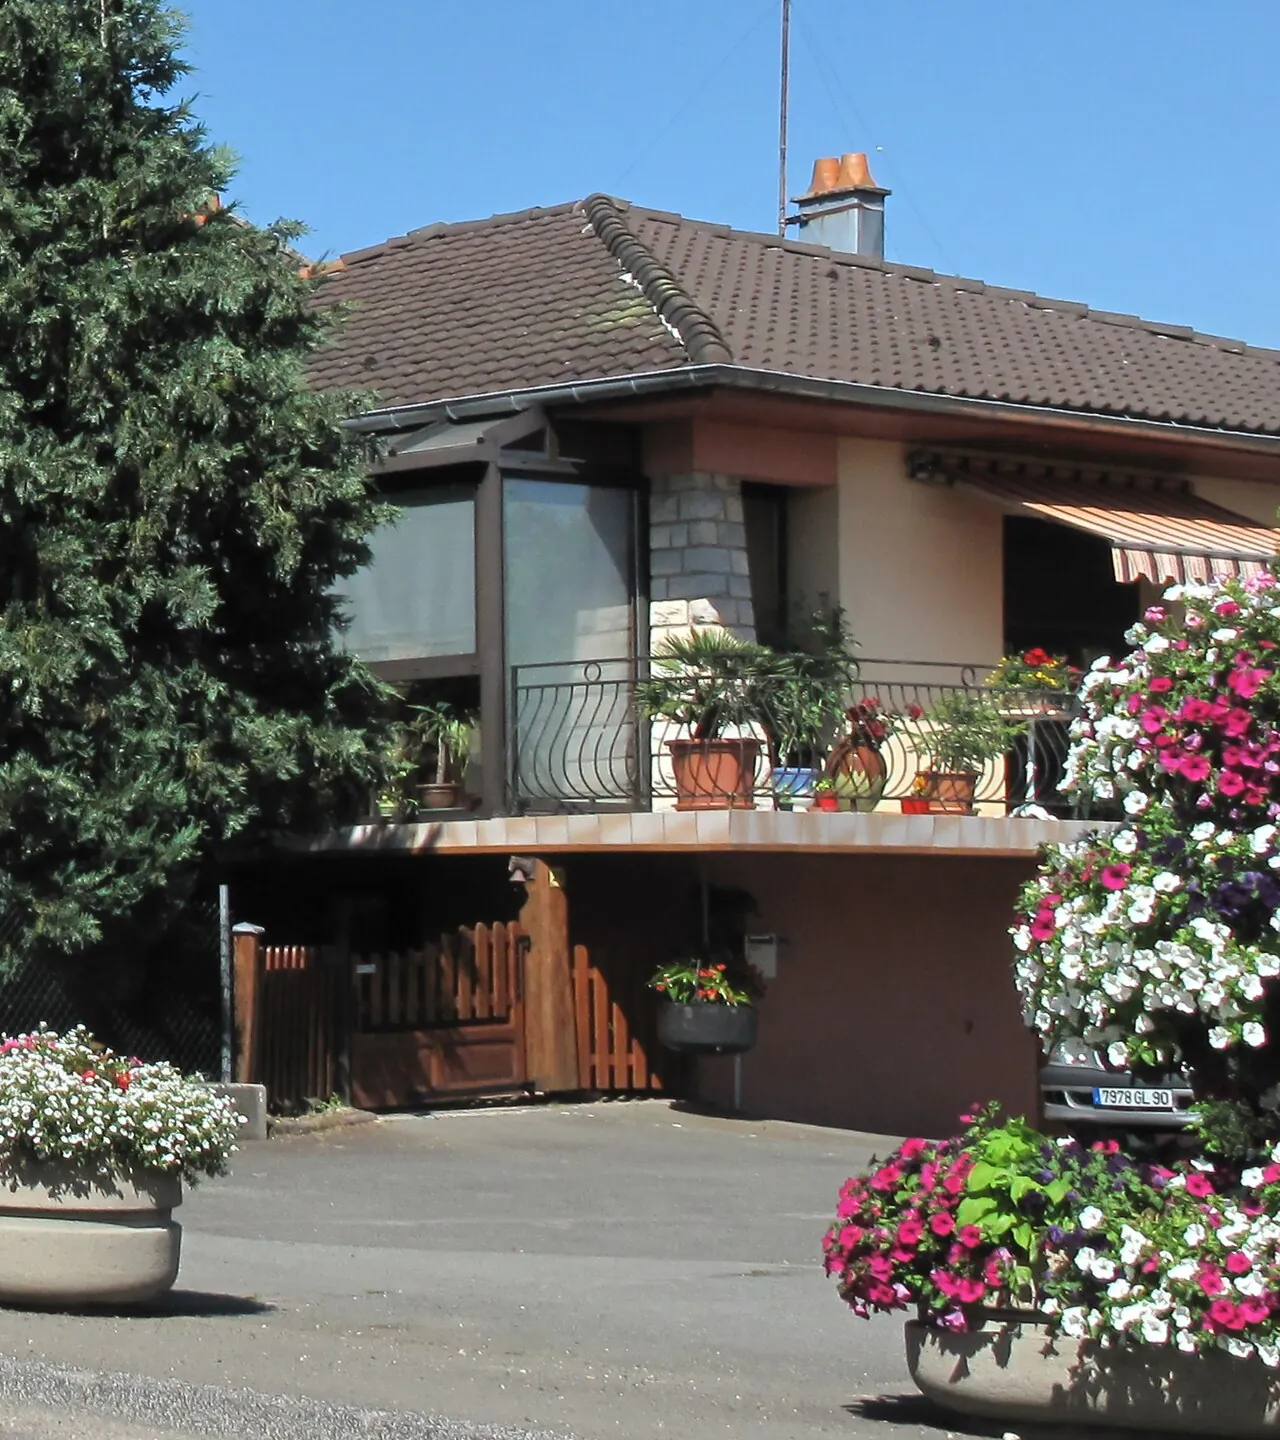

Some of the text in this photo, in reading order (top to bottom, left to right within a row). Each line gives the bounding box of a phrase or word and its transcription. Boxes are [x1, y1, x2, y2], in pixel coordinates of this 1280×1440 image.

[1102, 1090, 1169, 1105] 7978 GL 90
